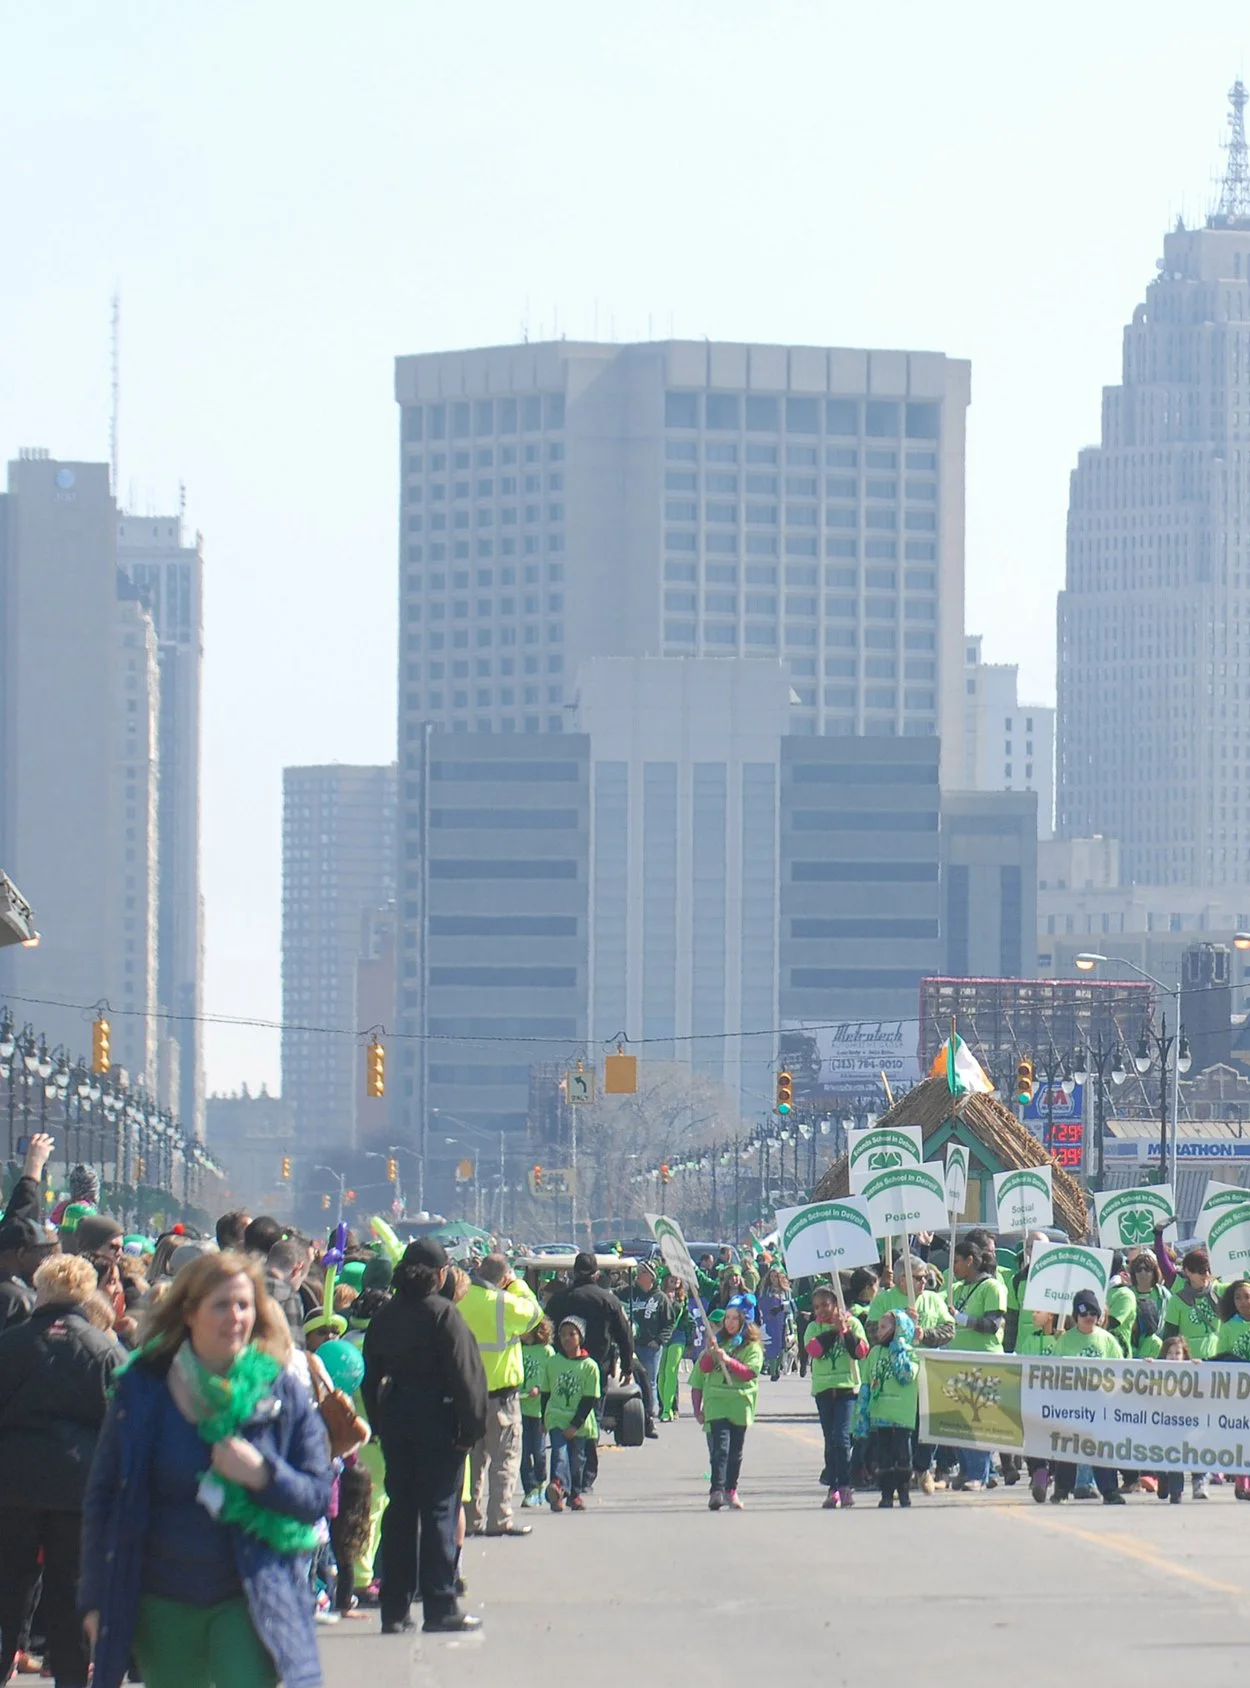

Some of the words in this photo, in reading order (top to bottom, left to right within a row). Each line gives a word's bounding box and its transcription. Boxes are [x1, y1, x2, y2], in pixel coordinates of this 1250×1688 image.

[832, 1022, 903, 1042] Metrotech
[885, 1174, 907, 1184] School
[916, 1175, 938, 1191] Detroit
[1012, 1203, 1034, 1214] Social
[808, 1209, 832, 1220] School
[841, 1210, 864, 1225] Detroit
[885, 1211, 920, 1223] Peace
[1011, 1216, 1037, 1227] Justice
[1211, 1217, 1233, 1238] Friends
[816, 1247, 845, 1259] Love
[1035, 1254, 1057, 1271] Friends
[1058, 1251, 1080, 1260] School
[1086, 1258, 1104, 1278] Detroit
[1044, 1288, 1074, 1301] Equal
[1028, 1364, 1115, 1393] FRIENDS
[1121, 1368, 1204, 1399] SCHOOL
[1210, 1370, 1231, 1399] IN
[1042, 1405, 1095, 1423] Diversity
[1114, 1409, 1147, 1425] Small
[1151, 1411, 1199, 1427] Classes
